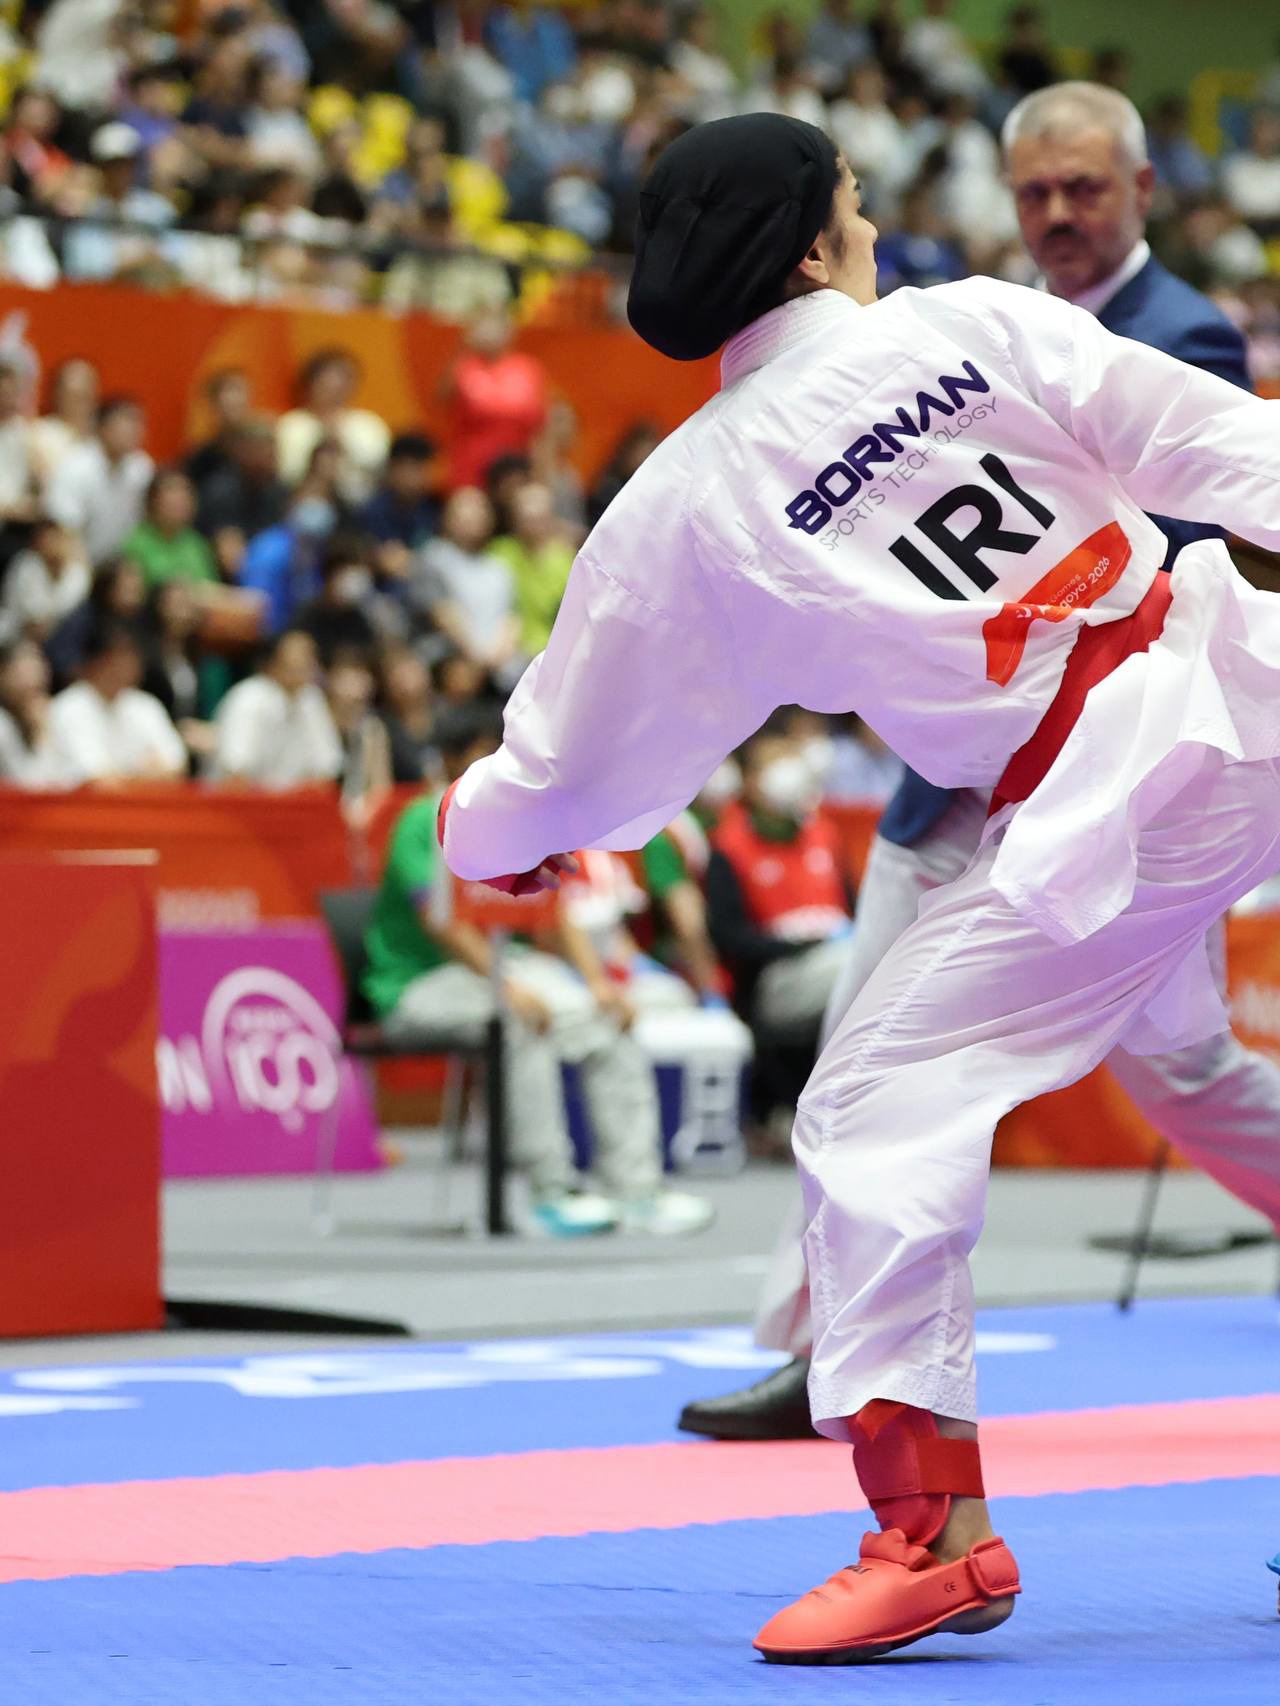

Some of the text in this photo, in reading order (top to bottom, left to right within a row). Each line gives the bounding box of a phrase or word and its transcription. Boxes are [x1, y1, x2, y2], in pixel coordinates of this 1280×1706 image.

[785, 360, 990, 535] BORNAN
[819, 487, 886, 551] SPORTS
[888, 453, 1056, 600] IRI
[1060, 556, 1110, 608] goya 2026
